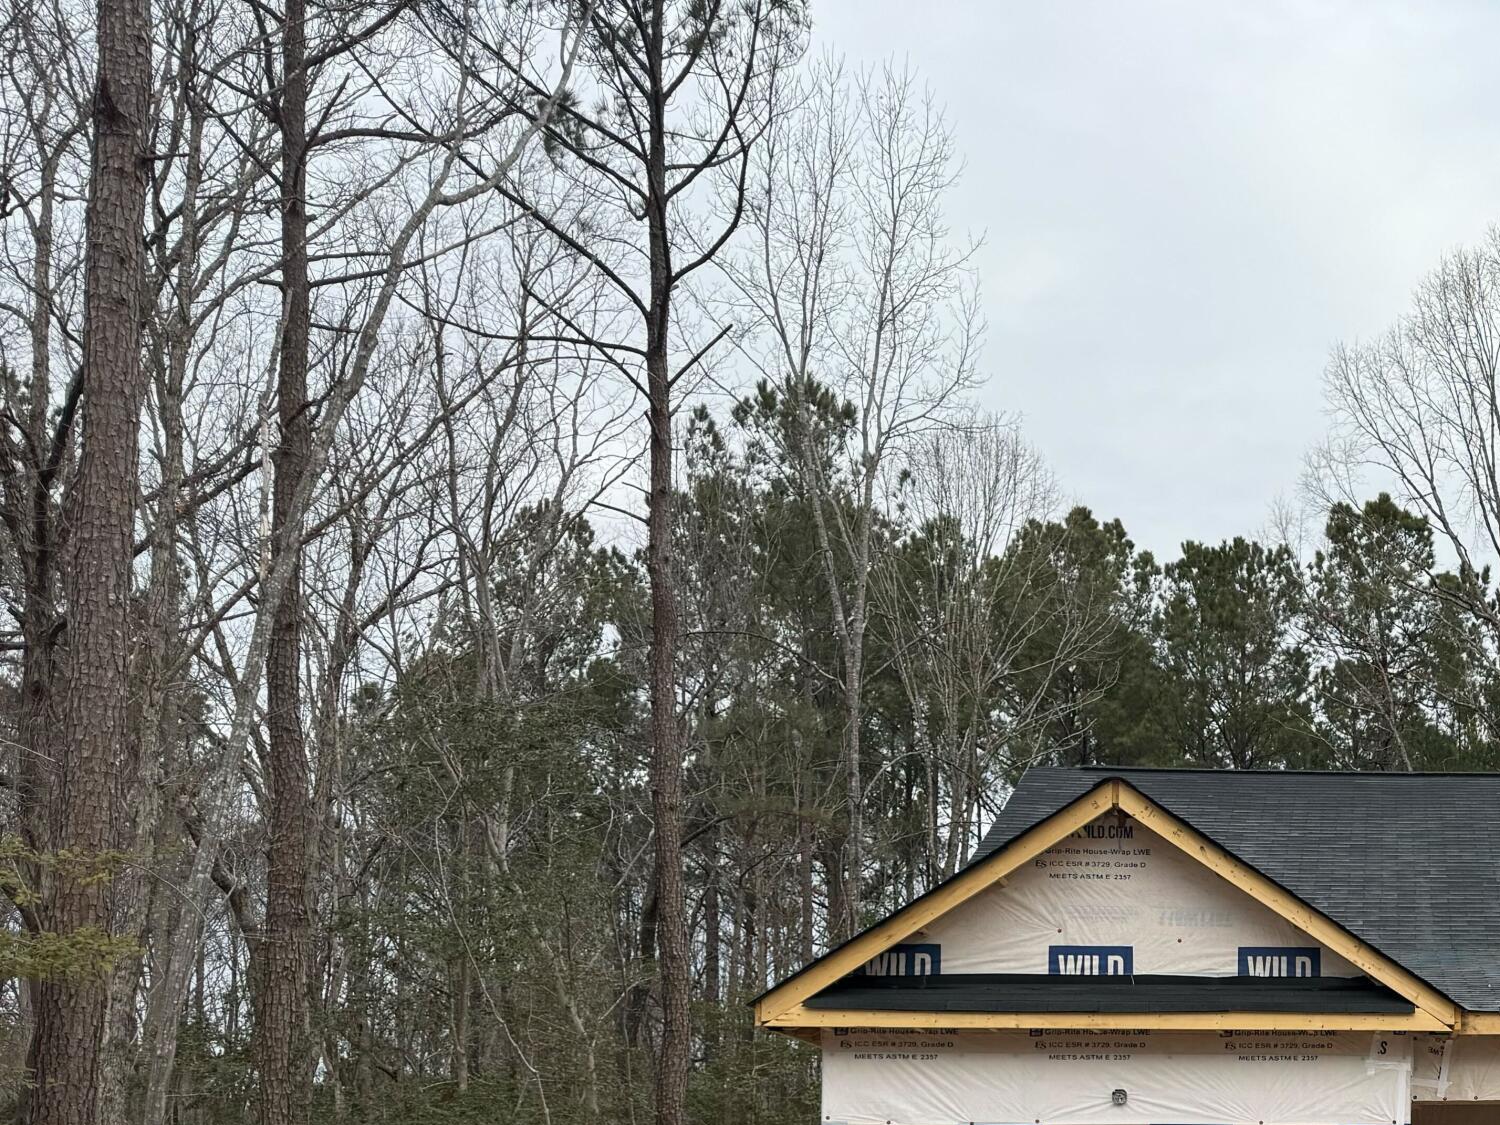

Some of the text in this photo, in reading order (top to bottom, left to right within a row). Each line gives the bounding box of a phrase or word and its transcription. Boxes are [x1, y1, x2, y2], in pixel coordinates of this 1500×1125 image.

[1133, 847, 1151, 856] LWE
[1049, 860, 1064, 868] ICC
[1114, 860, 1139, 868] Grade
[865, 952, 932, 976] WILD
[1057, 954, 1125, 976] WILD
[1247, 956, 1312, 977] WILD
